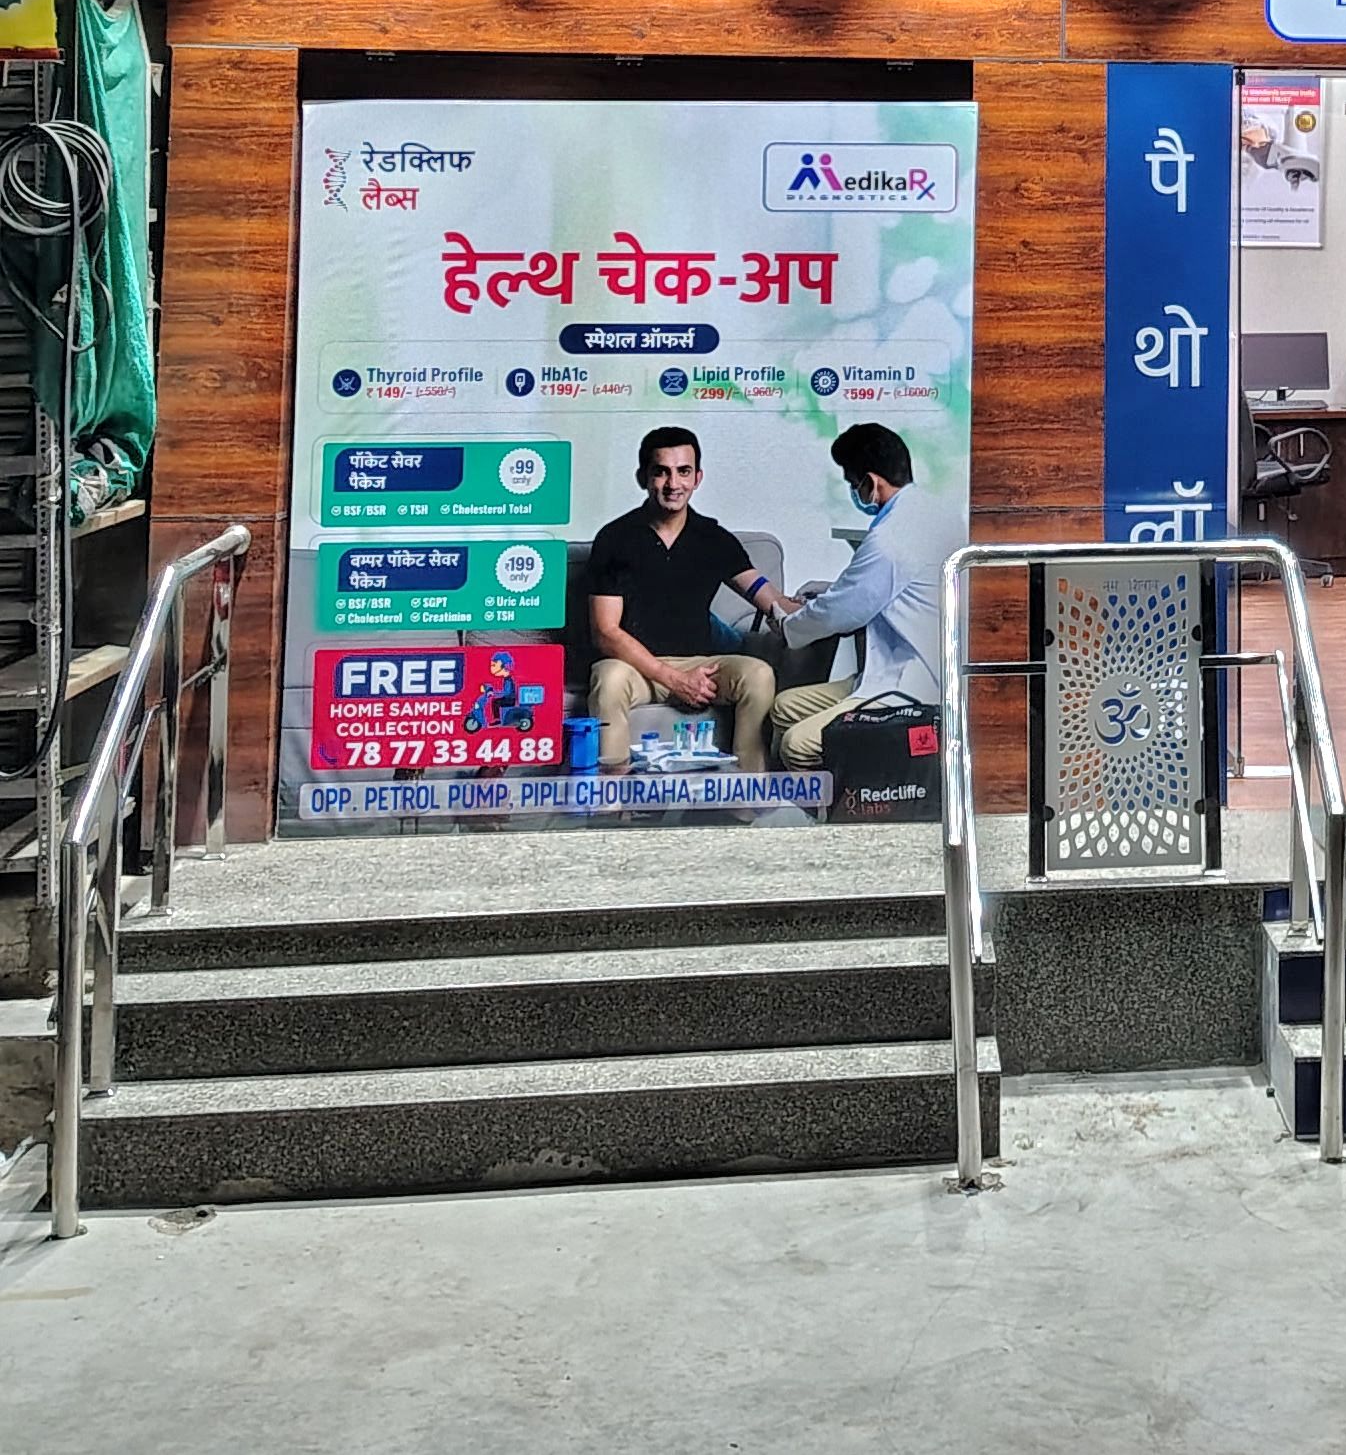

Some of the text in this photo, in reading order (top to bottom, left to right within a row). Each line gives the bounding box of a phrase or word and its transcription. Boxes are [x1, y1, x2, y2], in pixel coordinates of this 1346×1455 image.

[360, 141, 476, 173] रेडक्लिफ
[359, 177, 420, 210] लैब्स
[441, 231, 839, 315] हेल्थ चेक-अप
[583, 327, 696, 351] स्पेशल ऑफर्स
[366, 367, 484, 385] Thyroid Profile
[541, 366, 588, 382] HbA1c
[693, 366, 786, 384] Lipid Profile
[842, 365, 915, 381] Vitamin D
[410, 503, 429, 516] TSH
[452, 503, 506, 516] Cholesterol
[508, 503, 532, 515] Total
[509, 572, 529, 584] only
[496, 595, 516, 608] Uric
[519, 595, 540, 607] Acid
[348, 612, 403, 625] Cholesterol
[496, 610, 515, 622] TSH
[341, 659, 457, 696] FREE
[330, 700, 463, 719] HOME SAMPLE
[336, 720, 454, 737] COLLECTION
[346, 738, 554, 766] 78 77 33 44 88
[311, 786, 357, 813] OPP.
[365, 784, 440, 811] PETROL
[522, 781, 568, 807] PIPLI
[705, 776, 821, 803] BIJAINAGAR
[860, 784, 926, 802] Redcliffe
